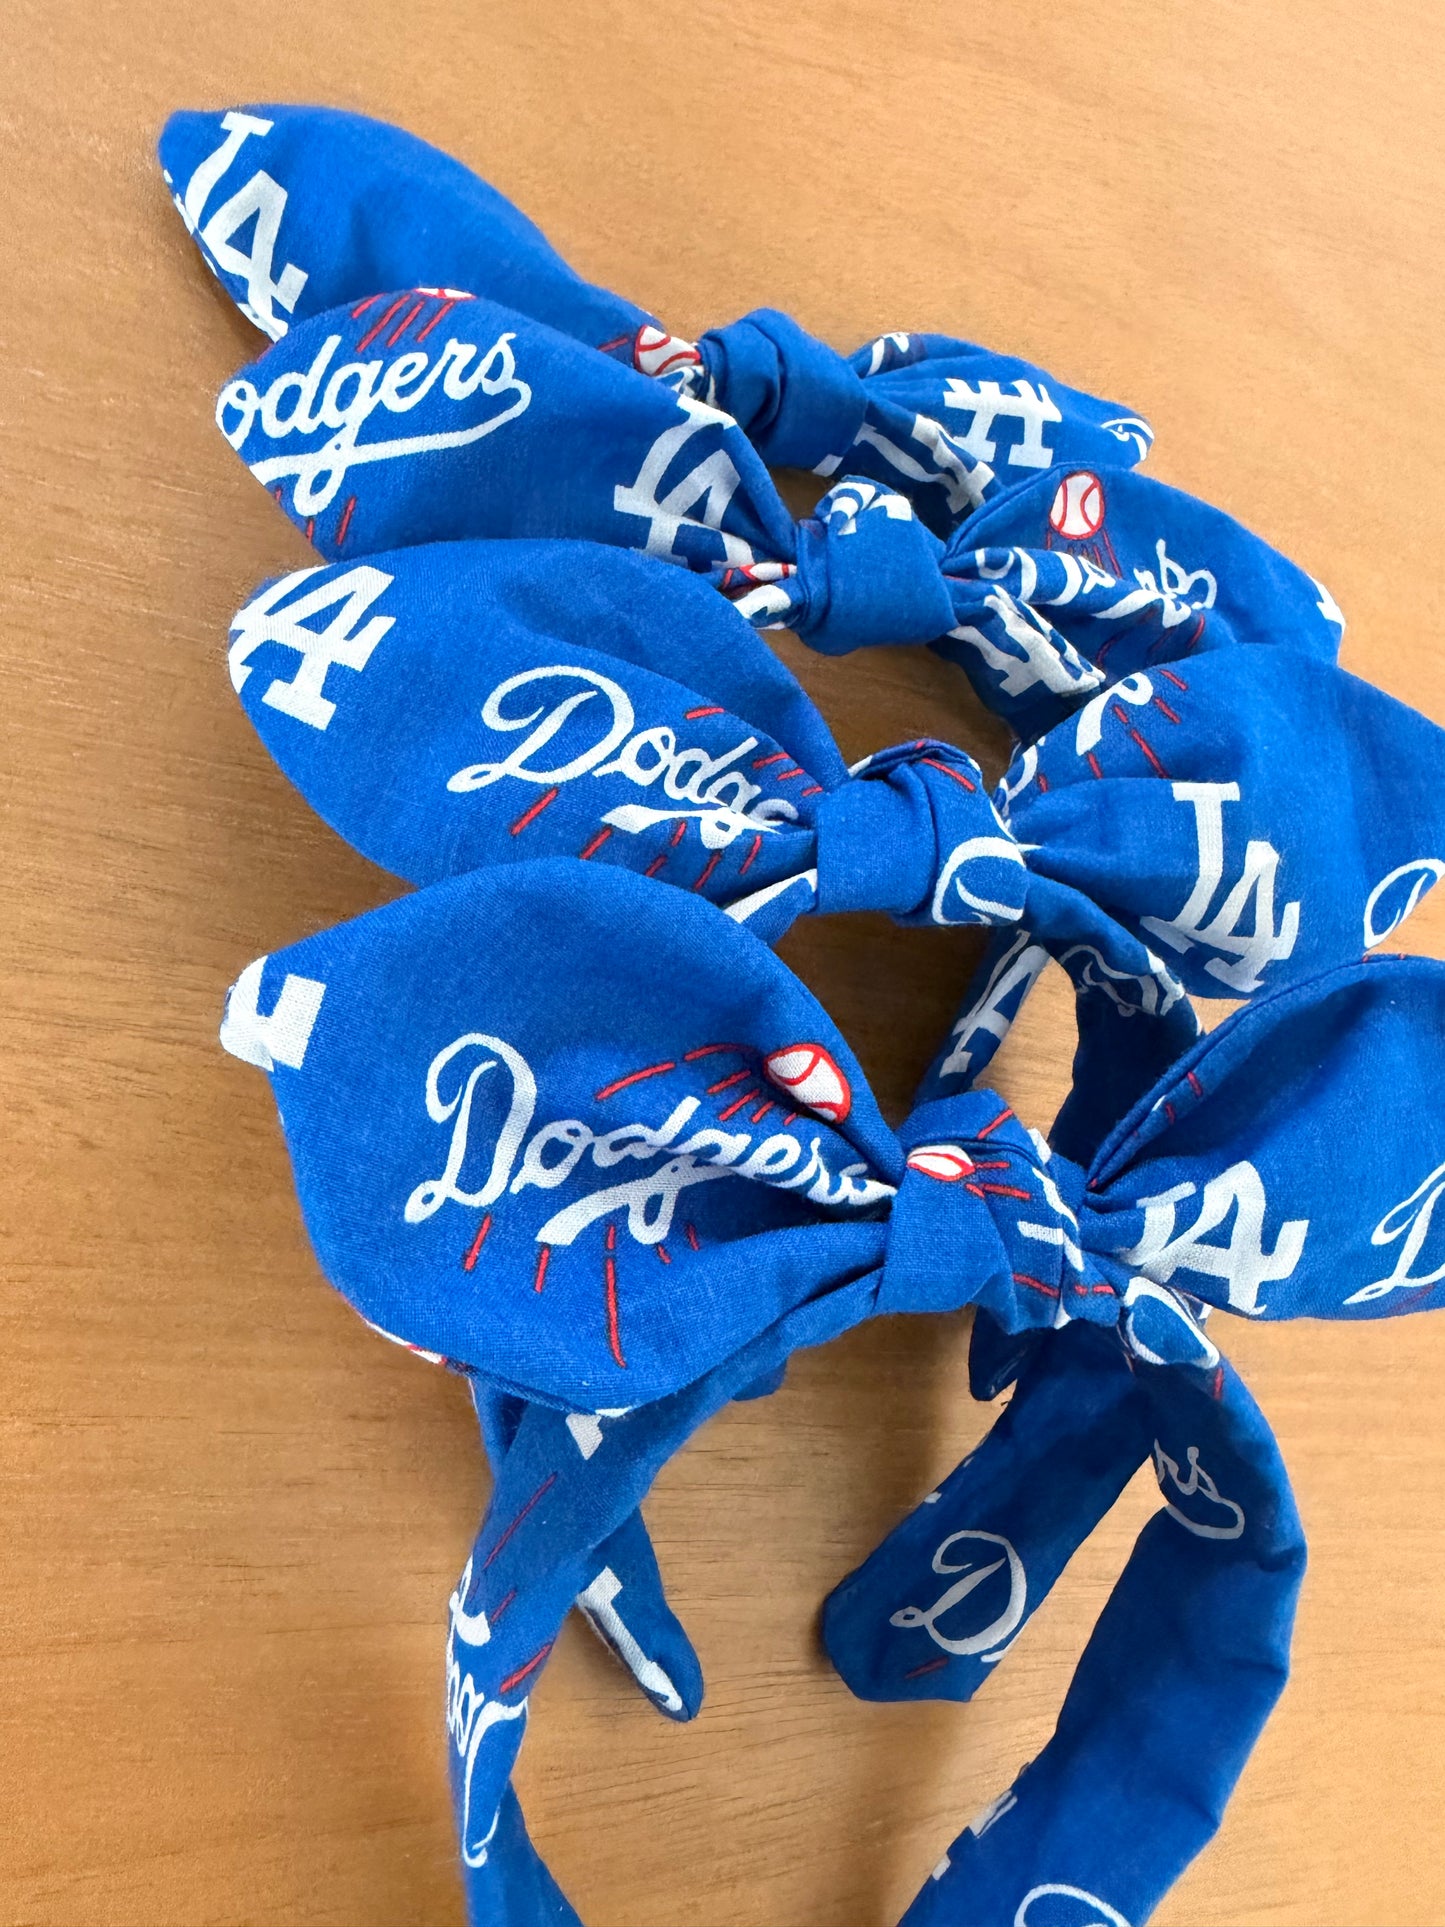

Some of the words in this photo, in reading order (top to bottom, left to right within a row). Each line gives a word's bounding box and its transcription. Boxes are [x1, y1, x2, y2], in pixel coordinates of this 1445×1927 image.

[613, 396, 754, 570] LA
[1140, 782, 1300, 993] LA
[404, 1033, 898, 1245] Dodgers
[1119, 1161, 1310, 1315] LA
